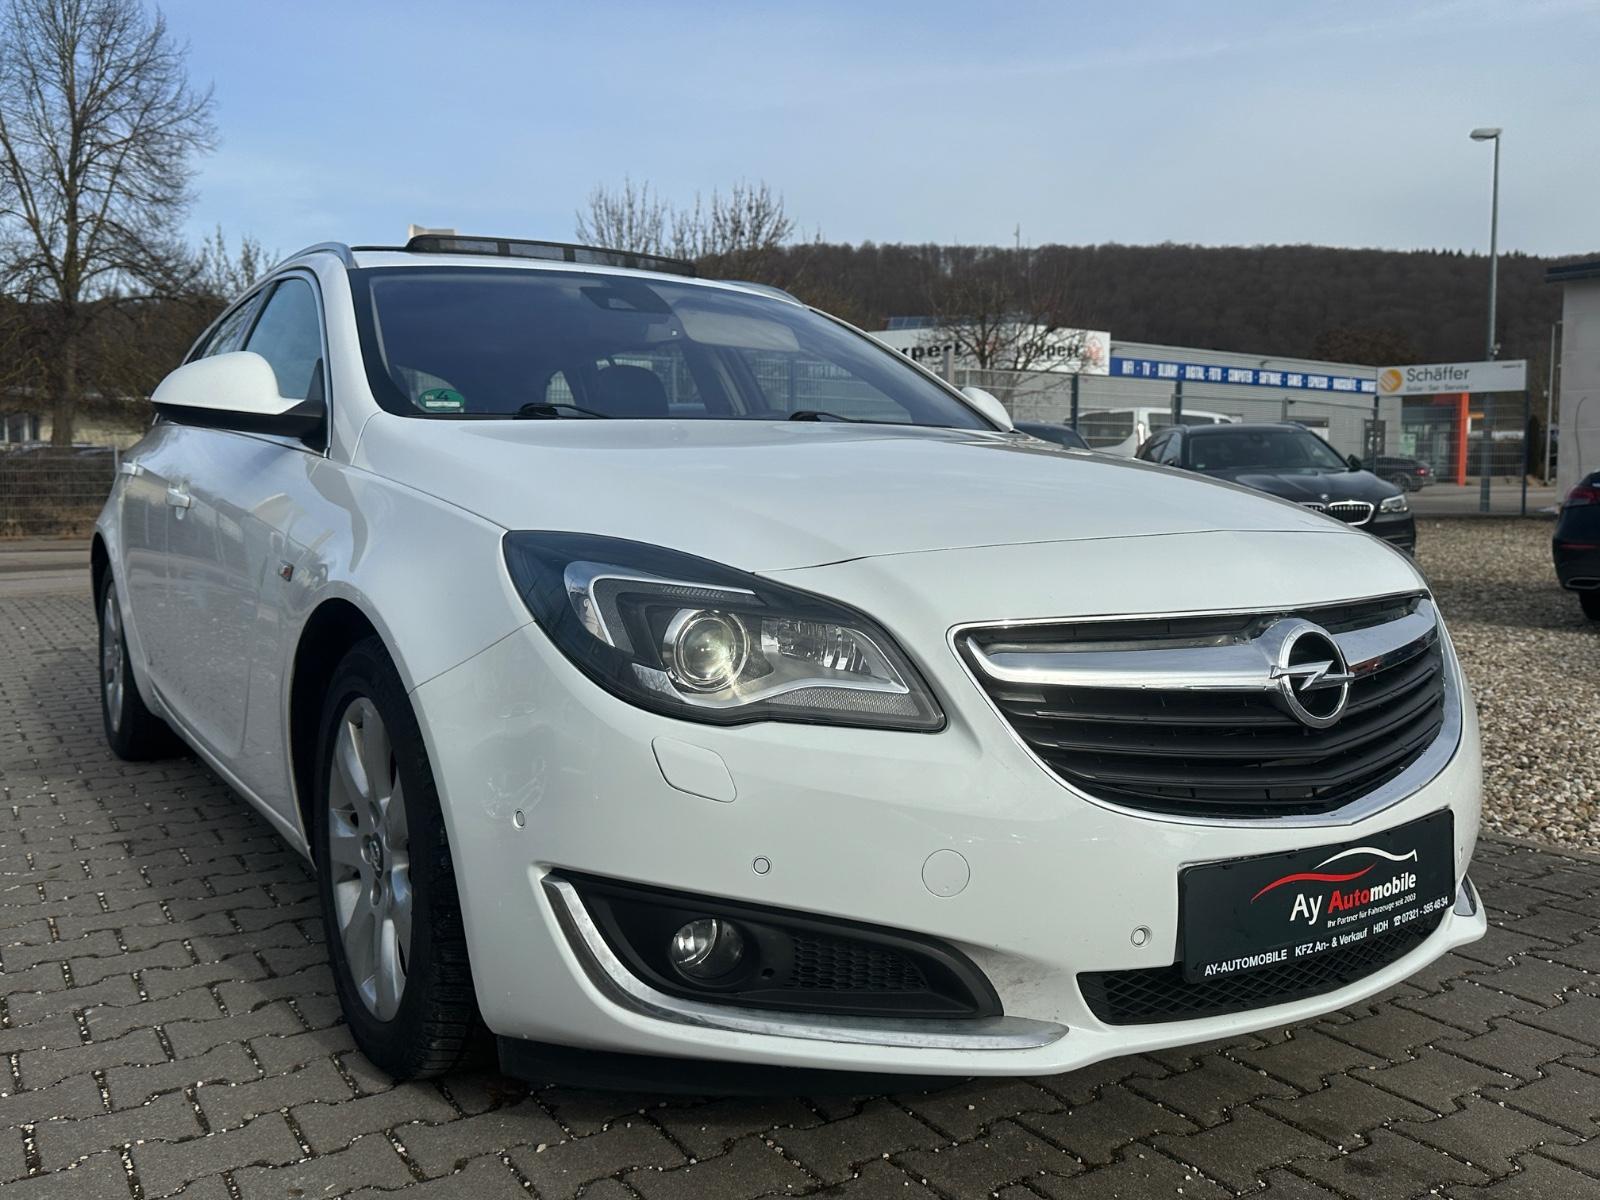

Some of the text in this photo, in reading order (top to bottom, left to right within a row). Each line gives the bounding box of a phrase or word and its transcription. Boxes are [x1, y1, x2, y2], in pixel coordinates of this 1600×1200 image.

[896, 340, 963, 361] xpert
[1407, 366, 1470, 382] Schäffer
[1289, 871, 1417, 925] Ay Automobile
[1327, 919, 1336, 928] Ihr
[1337, 913, 1358, 925] Partner
[1359, 910, 1367, 919] für
[1368, 902, 1395, 916] Fahrzeuge
[1395, 898, 1404, 908] seit
[1204, 949, 1288, 976] AY-AUTOMOBILE
[1295, 943, 1314, 957] KFZ
[1315, 940, 1329, 952] An-
[1331, 936, 1338, 948] &
[1339, 927, 1369, 945] Verkauf
[1373, 920, 1389, 934] HDH
[1401, 910, 1419, 923] 07321
